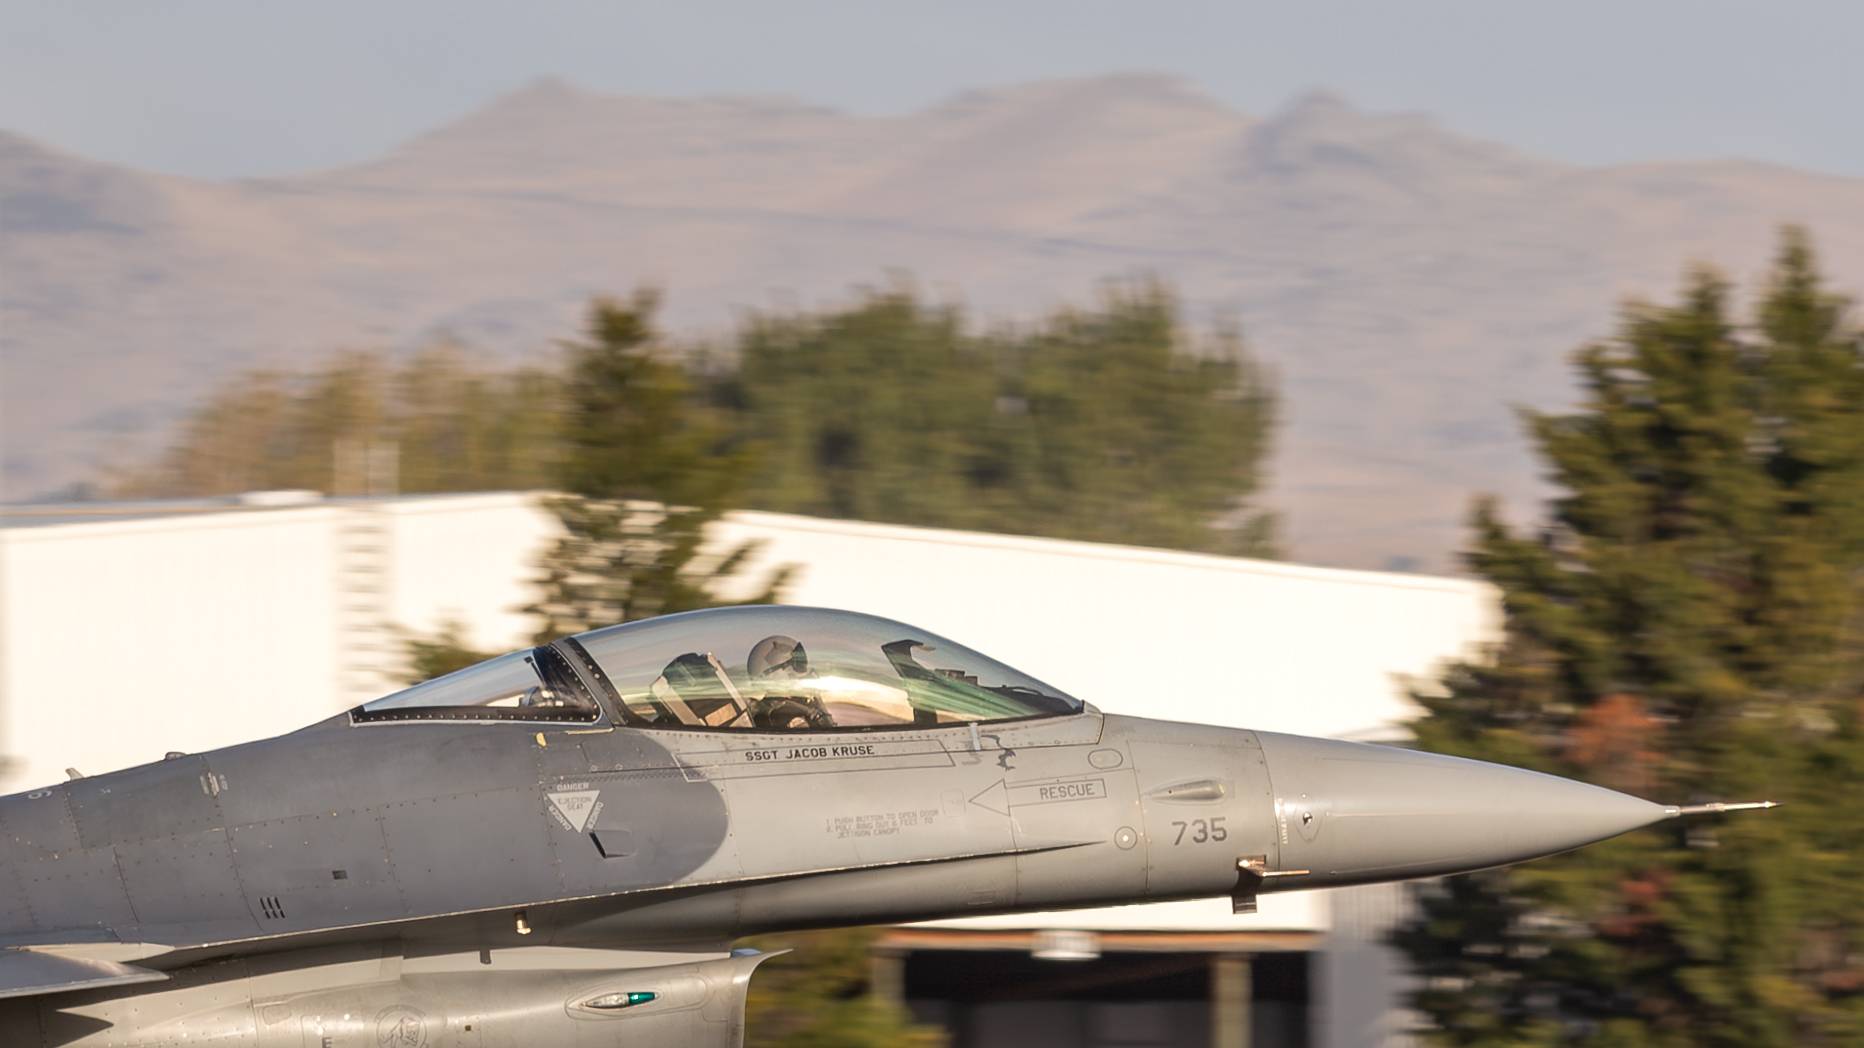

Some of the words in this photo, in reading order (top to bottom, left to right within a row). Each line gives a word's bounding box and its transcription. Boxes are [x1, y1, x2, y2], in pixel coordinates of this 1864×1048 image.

[745, 750, 778, 761] SSGT
[786, 747, 828, 759] JACOB
[832, 745, 875, 757] KRUSE
[1039, 783, 1096, 800] RESCUE
[1172, 816, 1227, 846] 735
